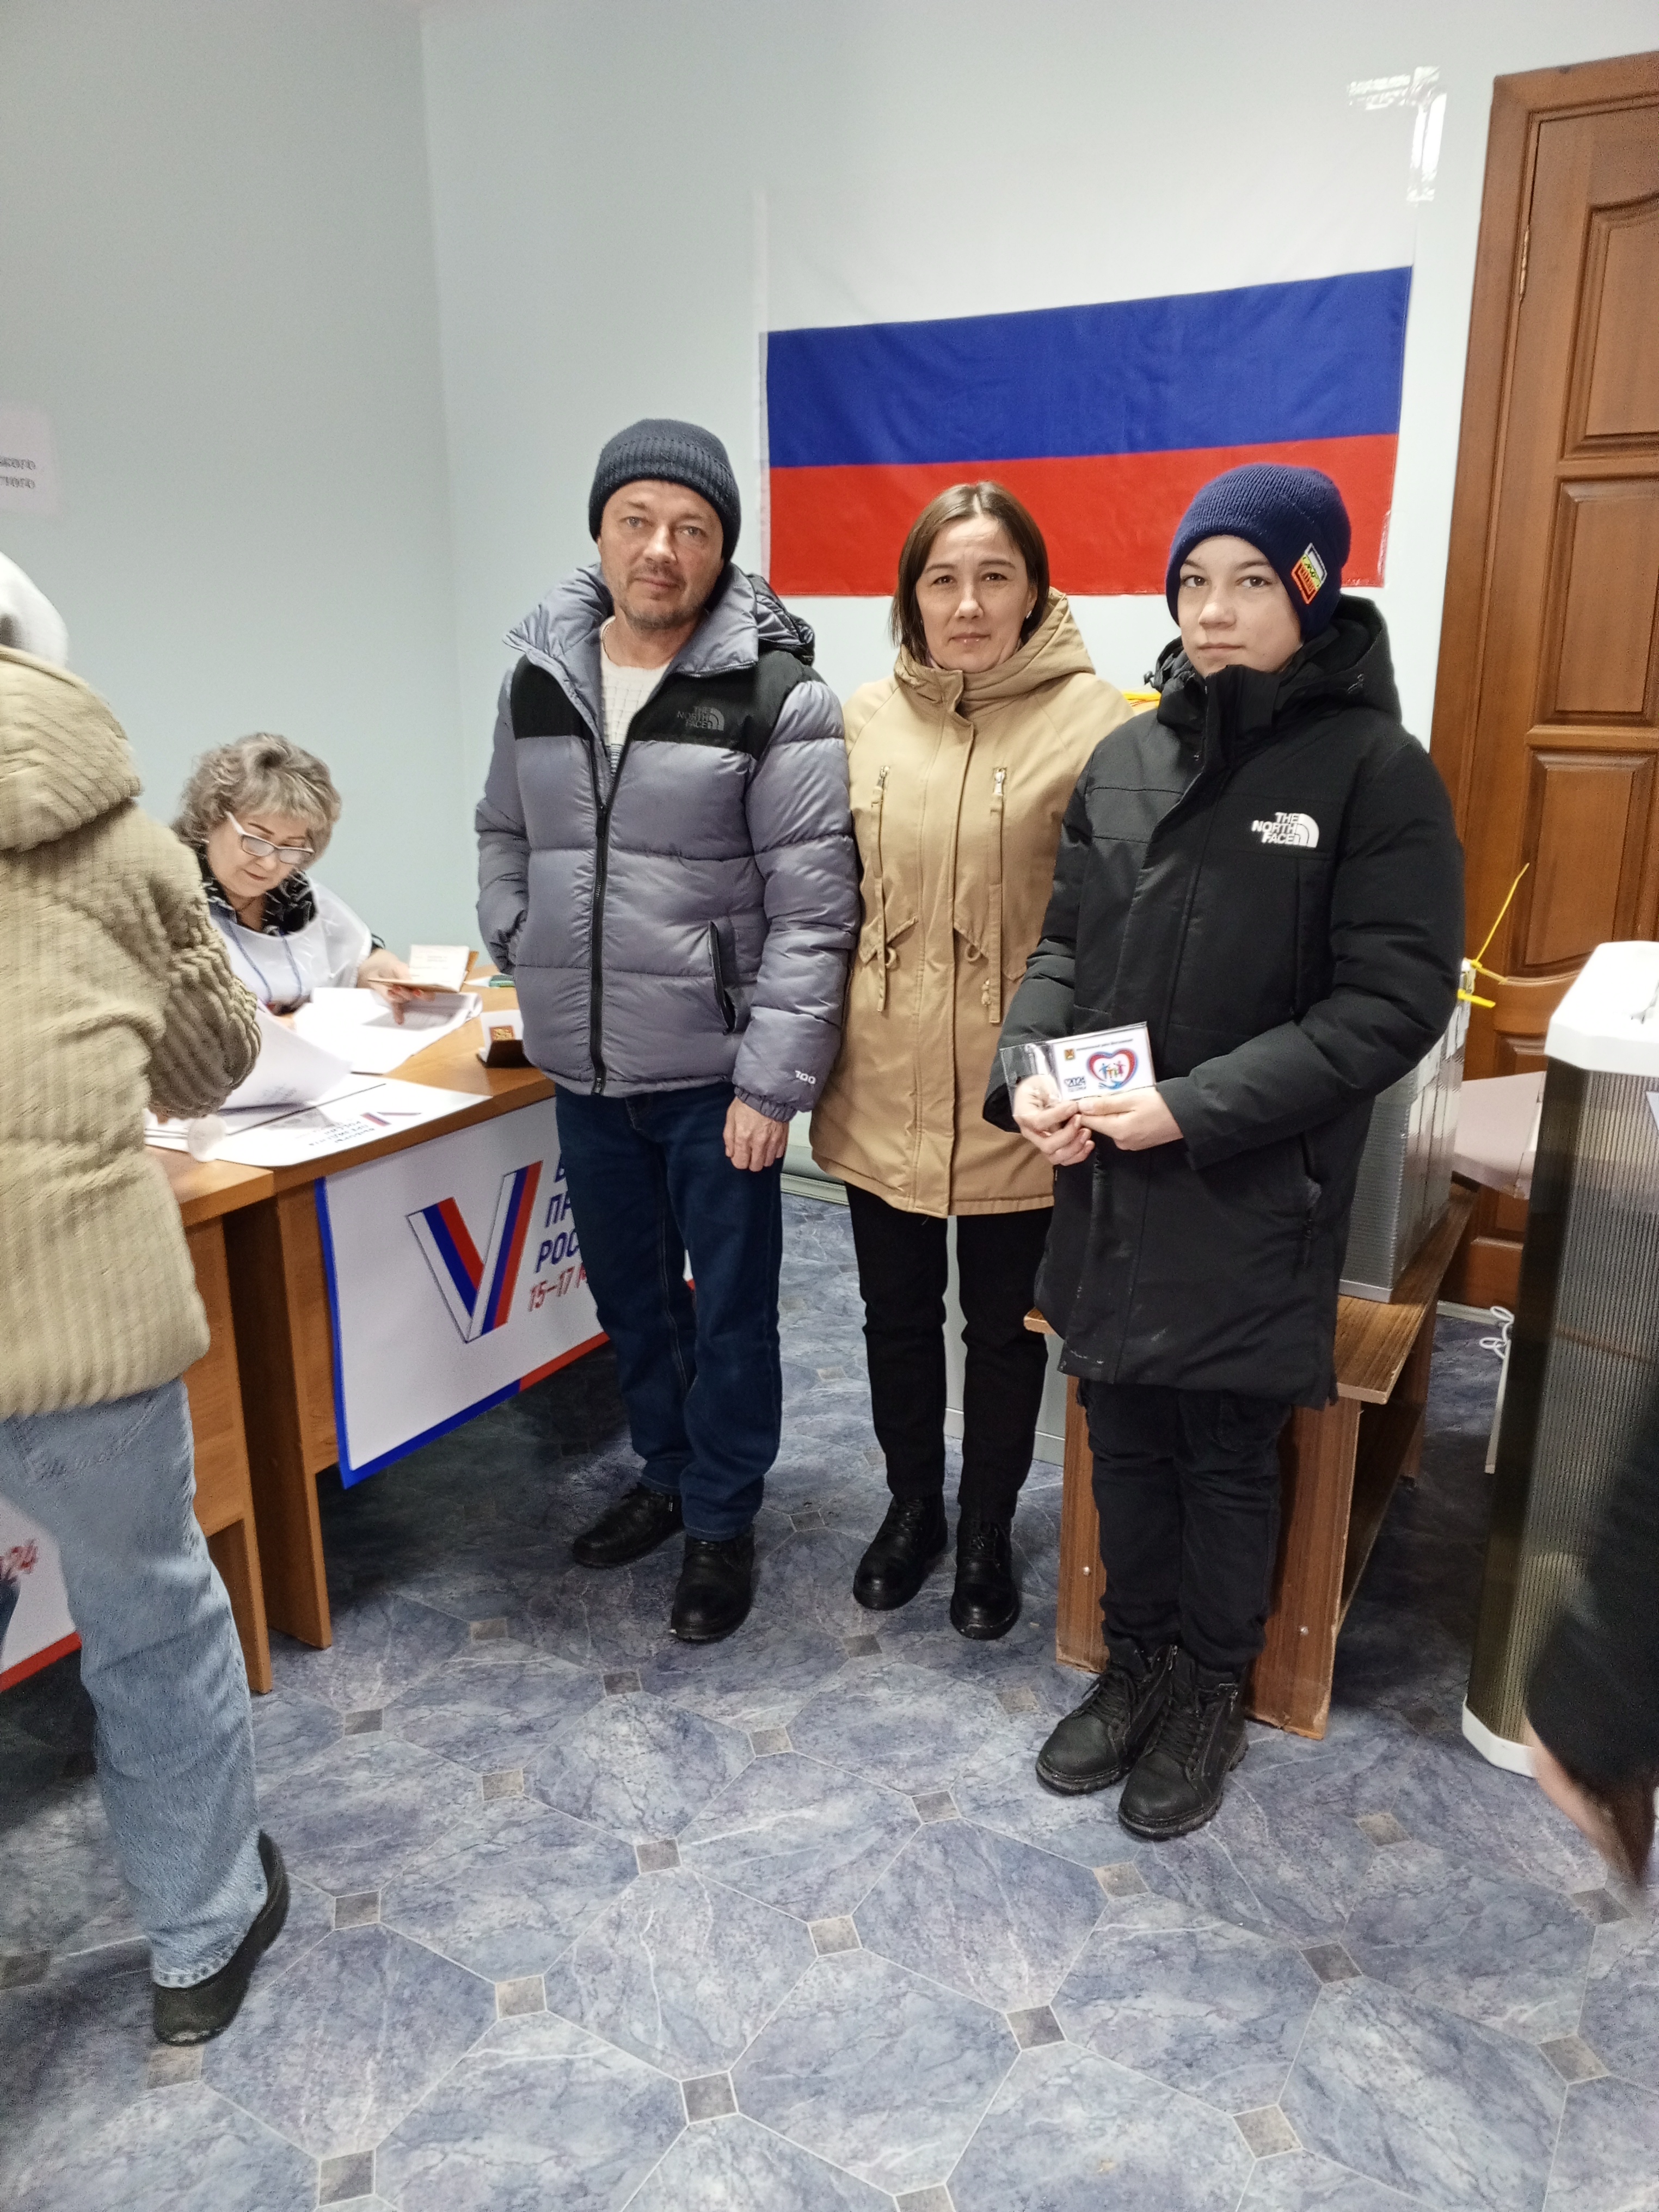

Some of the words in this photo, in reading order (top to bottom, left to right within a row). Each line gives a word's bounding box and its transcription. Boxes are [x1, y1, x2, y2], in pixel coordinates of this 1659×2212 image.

[677, 710, 710, 721] NORTH
[685, 720, 708, 728] FACE
[1275, 812, 1299, 824] THE
[1251, 820, 1297, 834] NORTH
[1261, 832, 1295, 845] FACE
[795, 1070, 816, 1084] 700
